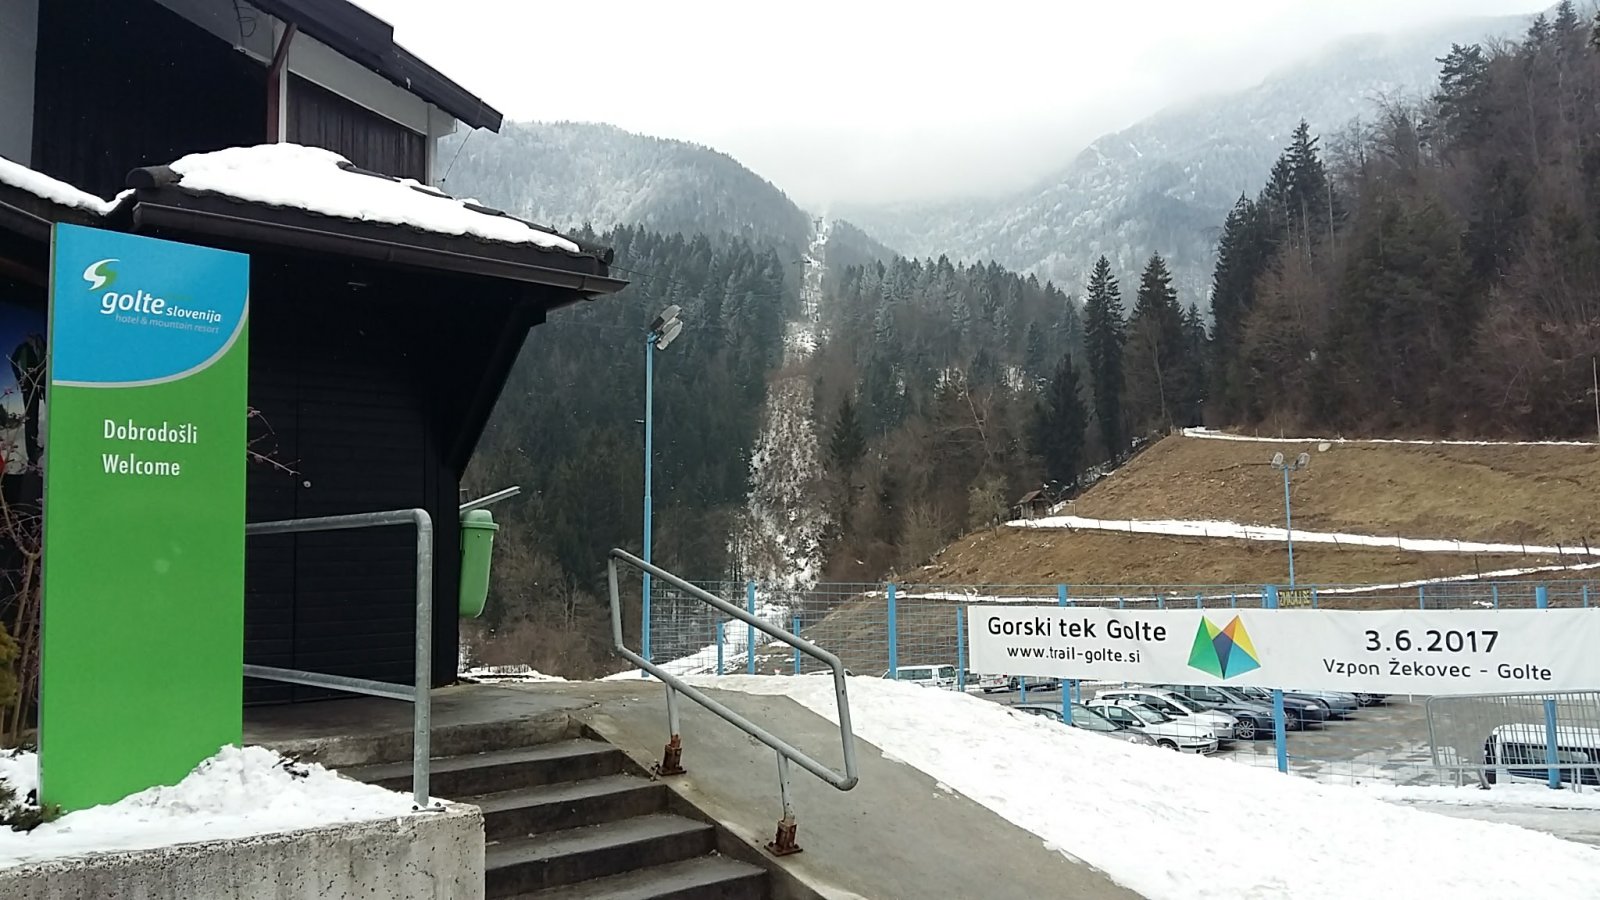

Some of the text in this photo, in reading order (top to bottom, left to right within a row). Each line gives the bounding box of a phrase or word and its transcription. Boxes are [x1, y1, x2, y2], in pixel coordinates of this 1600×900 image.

[101, 290, 222, 322] golte slovenija
[116, 313, 220, 334] hotel & mountain resort
[104, 420, 197, 443] Dobrodošli
[102, 454, 180, 475] Welcome
[987, 617, 1167, 641] Gorski tek Golte
[1365, 630, 1499, 652] 3.6.2017
[1006, 647, 1140, 663] www.trail-golte.si
[1322, 659, 1380, 677] Vzpon
[1388, 658, 1471, 677] Žekovec
[1497, 664, 1552, 680] Golte
